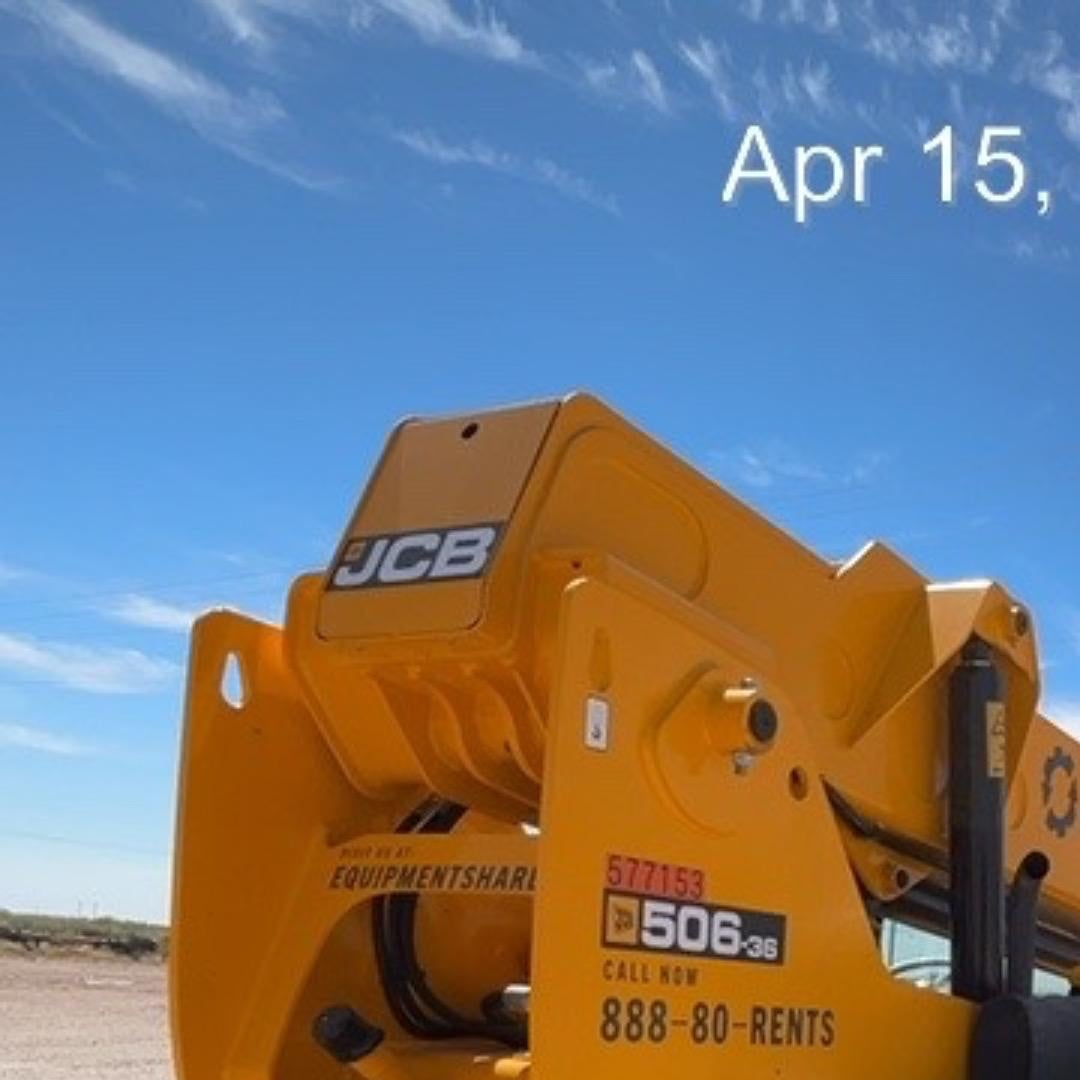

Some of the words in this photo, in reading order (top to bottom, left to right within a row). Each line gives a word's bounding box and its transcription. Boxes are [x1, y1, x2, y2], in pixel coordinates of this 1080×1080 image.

[334, 526, 496, 587] JCB
[607, 854, 704, 898] 577153
[602, 960, 650, 983] CALL
[660, 965, 699, 986] NOW
[601, 997, 835, 1047] 888-80-RENTS
